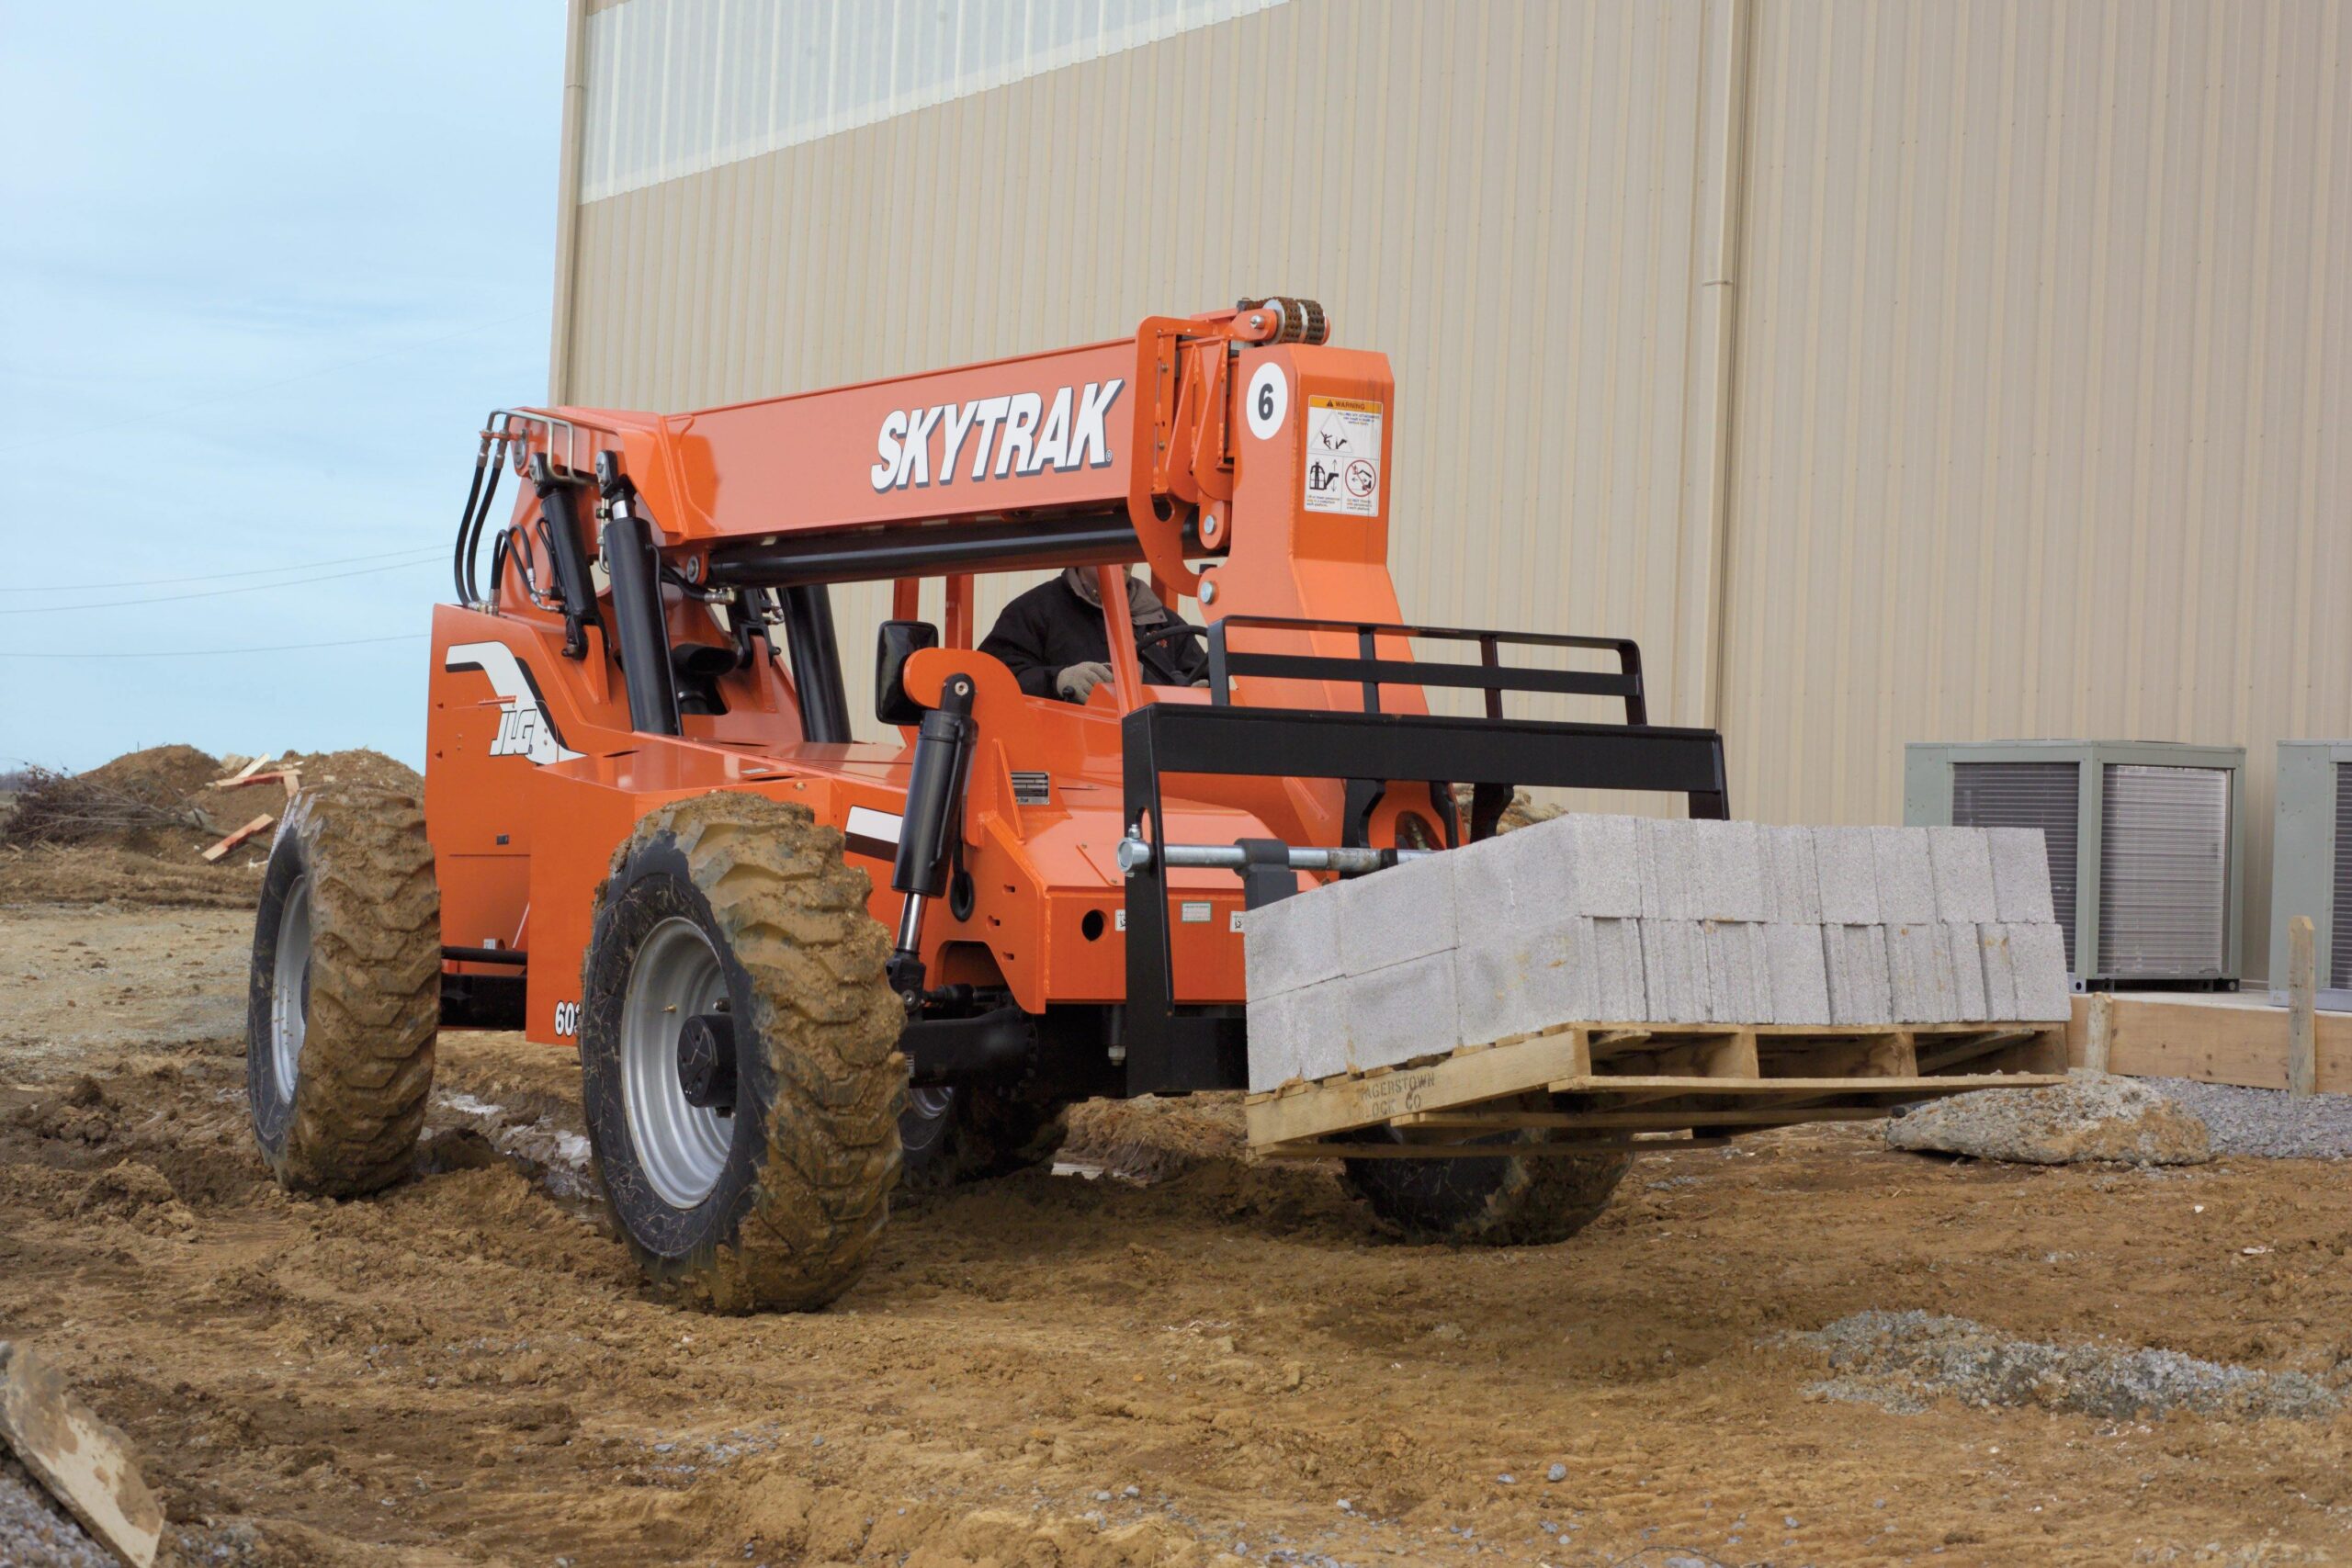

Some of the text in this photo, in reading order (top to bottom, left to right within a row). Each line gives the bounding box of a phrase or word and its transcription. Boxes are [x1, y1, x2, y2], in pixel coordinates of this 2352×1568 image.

[1258, 383, 1274, 421] 6
[1335, 400, 1366, 411] WARNING
[871, 378, 1125, 493] SKYTRAK
[488, 708, 537, 757] JLG
